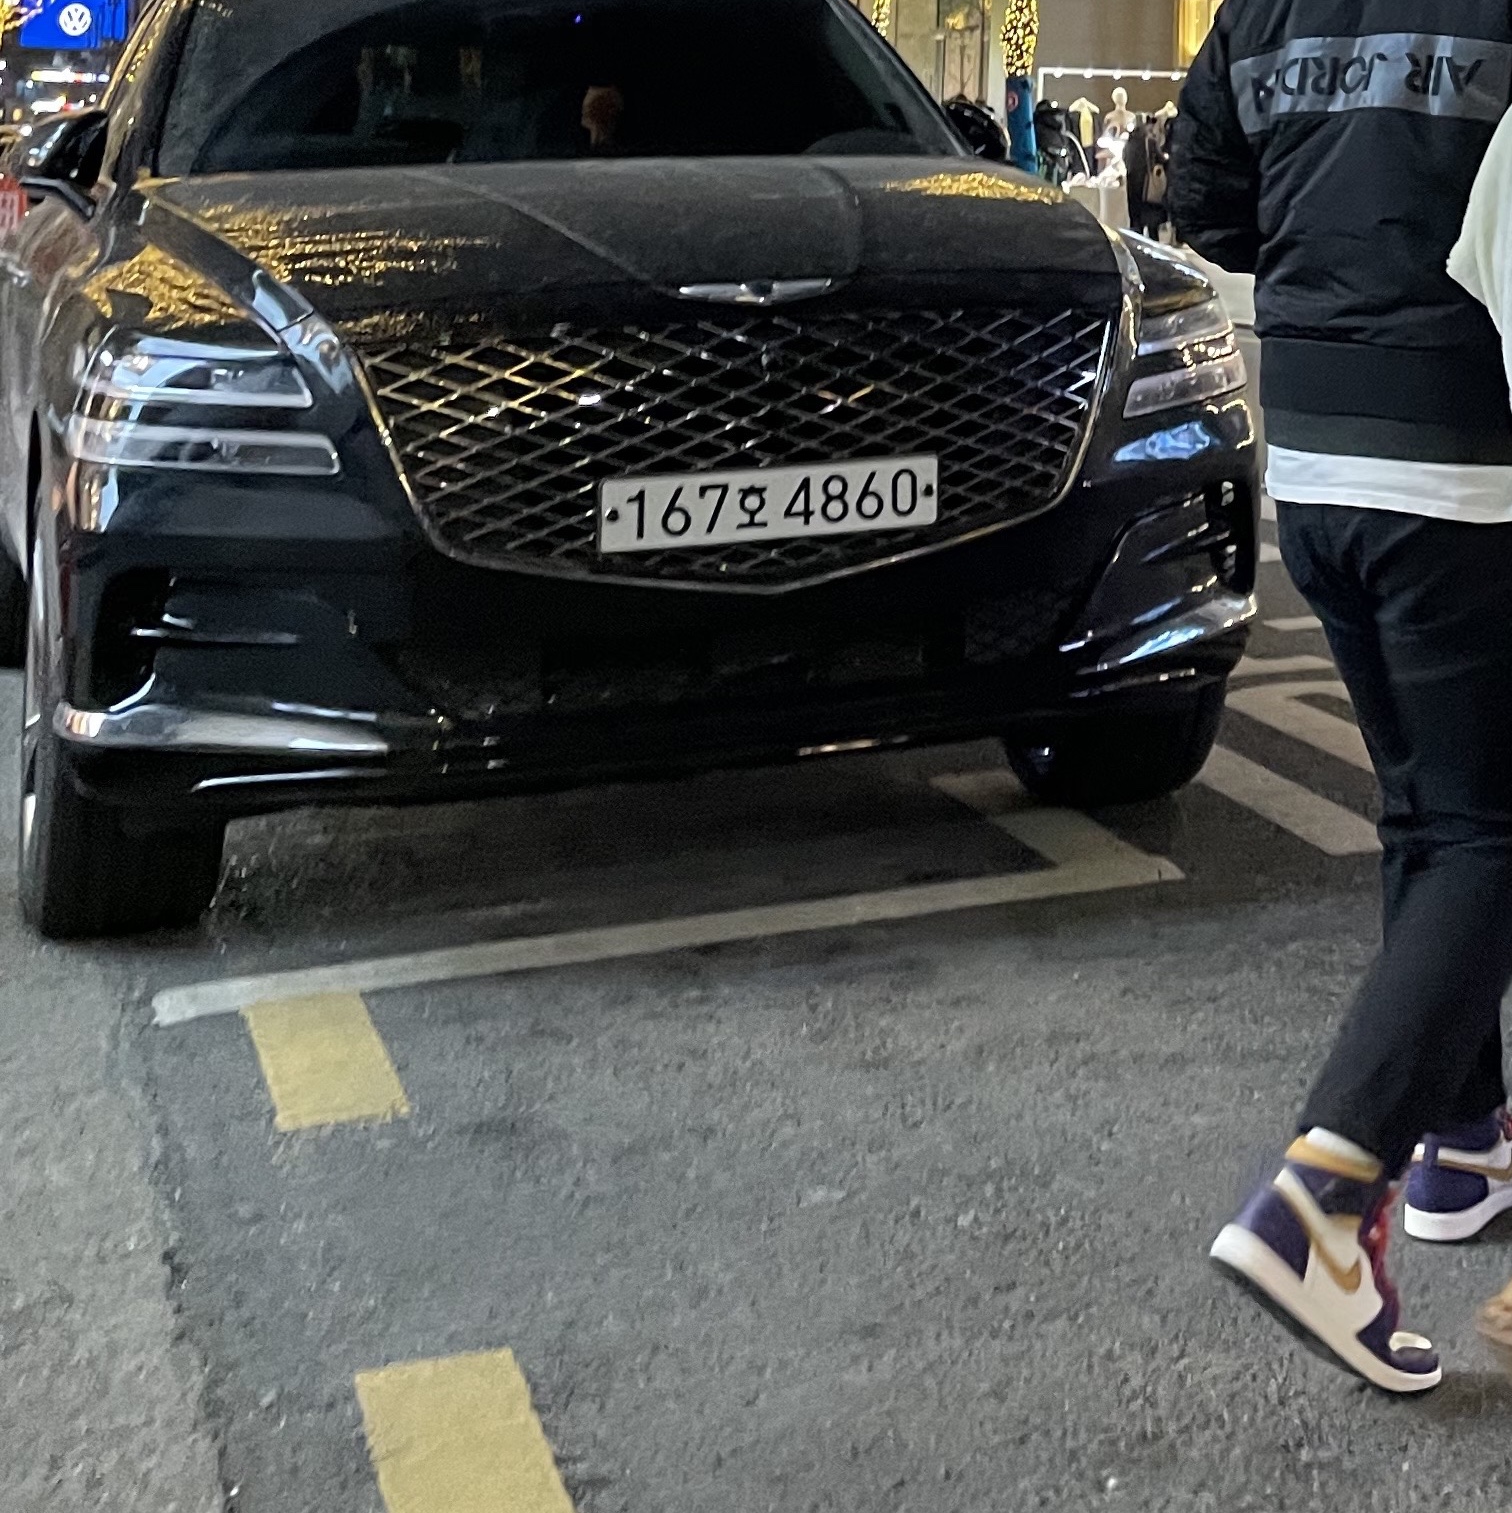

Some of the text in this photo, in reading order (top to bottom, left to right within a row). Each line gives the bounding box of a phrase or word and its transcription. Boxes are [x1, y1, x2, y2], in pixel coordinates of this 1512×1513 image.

[1404, 52, 1485, 96] AIR
[626, 467, 919, 541] 167호 4860
